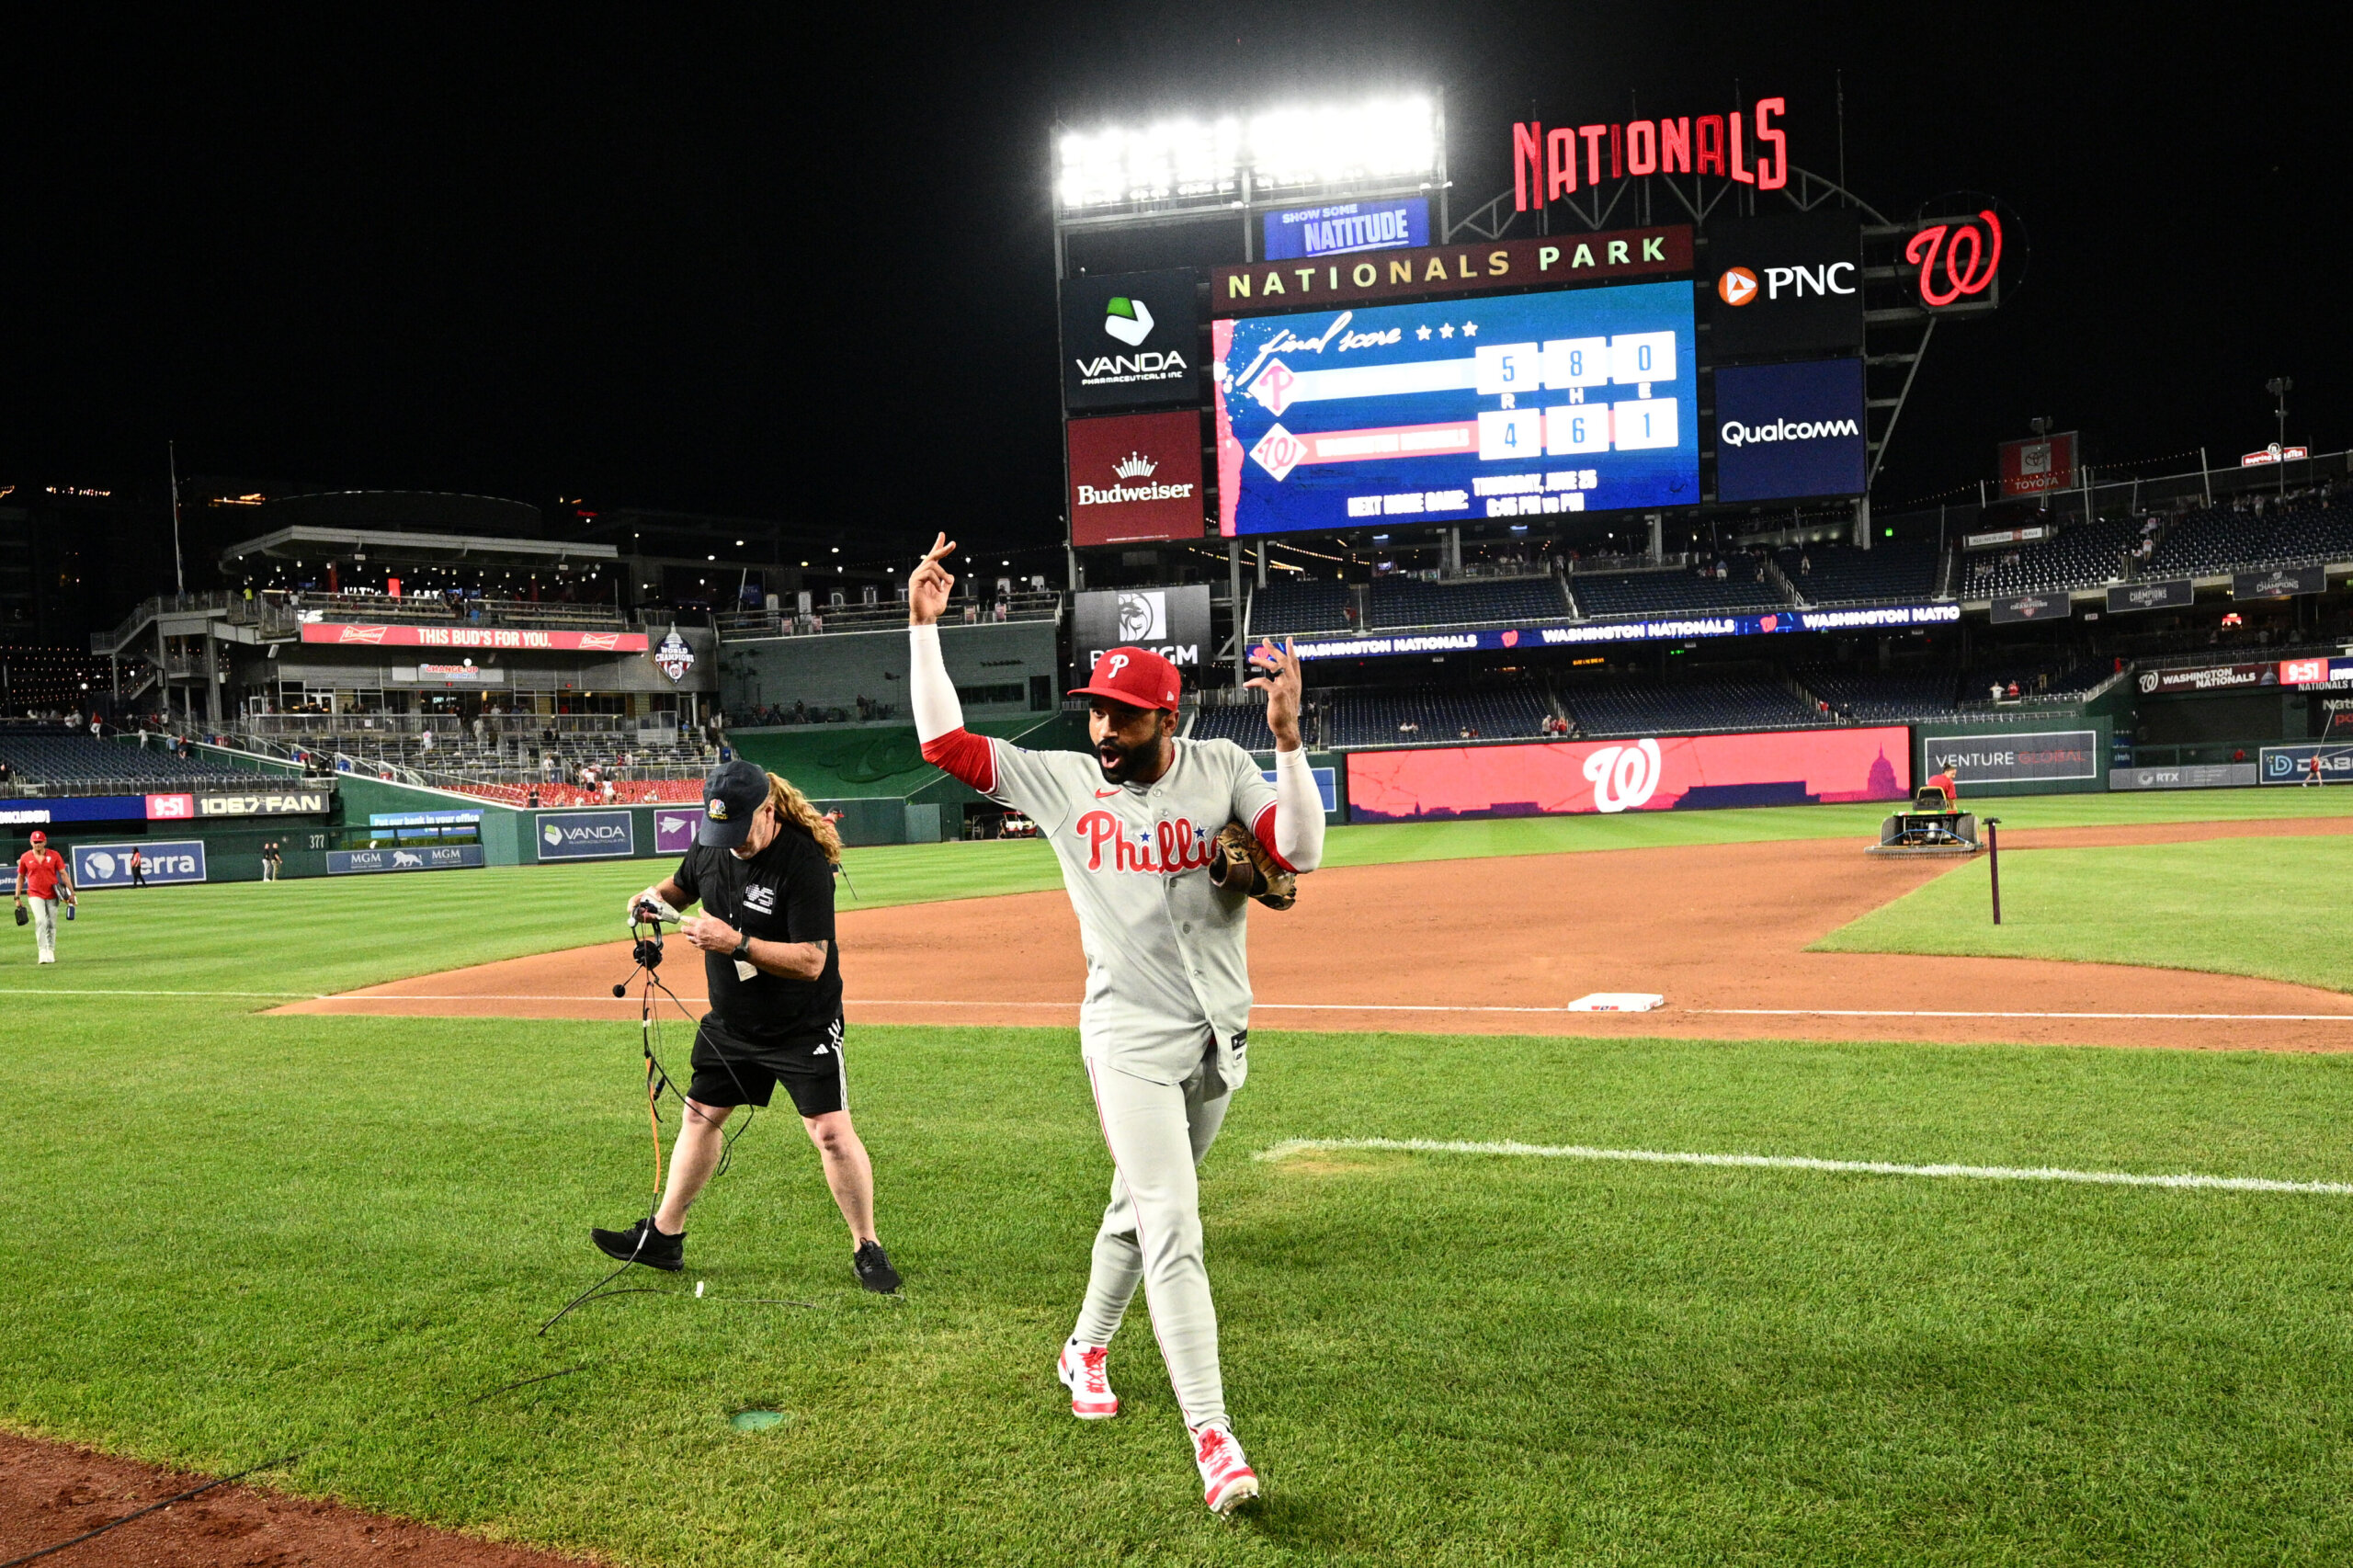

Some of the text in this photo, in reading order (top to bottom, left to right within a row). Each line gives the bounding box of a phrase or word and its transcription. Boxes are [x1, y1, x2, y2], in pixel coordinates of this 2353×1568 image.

[1513, 97, 1788, 211] NATIONALS
[1282, 204, 1358, 224] SHOW SOME
[1304, 209, 1409, 253] NATITUDE
[1229, 236, 1665, 299] NATIONALS PARK
[1764, 262, 1856, 300] PNC
[1236, 312, 1352, 386] final
[1339, 327, 1403, 352] score
[1076, 350, 1188, 377] VANDA
[1502, 356, 1516, 382] 5
[1570, 350, 1584, 377] 8
[1639, 345, 1652, 372] 0
[1082, 372, 1166, 385] PHARMACEUTICALS
[1501, 383, 1651, 409] R H E
[1504, 422, 1518, 448] 4
[1572, 417, 1586, 444] 6
[1643, 413, 1651, 438] 1
[1722, 418, 1859, 447] Qualcomm
[2015, 476, 2059, 490] TOYOTA
[1077, 481, 1193, 506] Budweiser
[2129, 587, 2167, 603] CHAMPIONS
[2256, 581, 2299, 593] CHAMPIONS
[1802, 606, 1961, 629] WASHINGTON NATIO
[417, 629, 552, 647] THIS BUD'S FOR YOU.
[1542, 619, 1734, 643] WASHINGTON NATIONALS
[1293, 634, 1477, 658] WASHINGTON NATIONALS
[655, 653, 694, 662] CHAMPIONS
[1108, 654, 1129, 678] P
[2163, 667, 2233, 685] WASHINGTON
[2196, 673, 2256, 688] NATIONALS
[2289, 663, 2319, 681] 9:51
[2298, 680, 2348, 691] NATIONALS
[1936, 750, 2086, 767] VENTURE GLOBAL
[2156, 772, 2179, 782] RTX
[154, 797, 184, 816] 9:51
[201, 798, 259, 814] 106.7
[266, 795, 321, 812] FAN
[404, 815, 425, 824] bank
[426, 815, 435, 824] in
[436, 814, 455, 824] your
[456, 812, 480, 823] office
[310, 835, 324, 849] 377
[563, 825, 625, 840] VANDA
[1076, 810, 1220, 874] Philli
[118, 851, 196, 876] Terra
[351, 853, 381, 864] MGM
[432, 849, 460, 859] MGM
